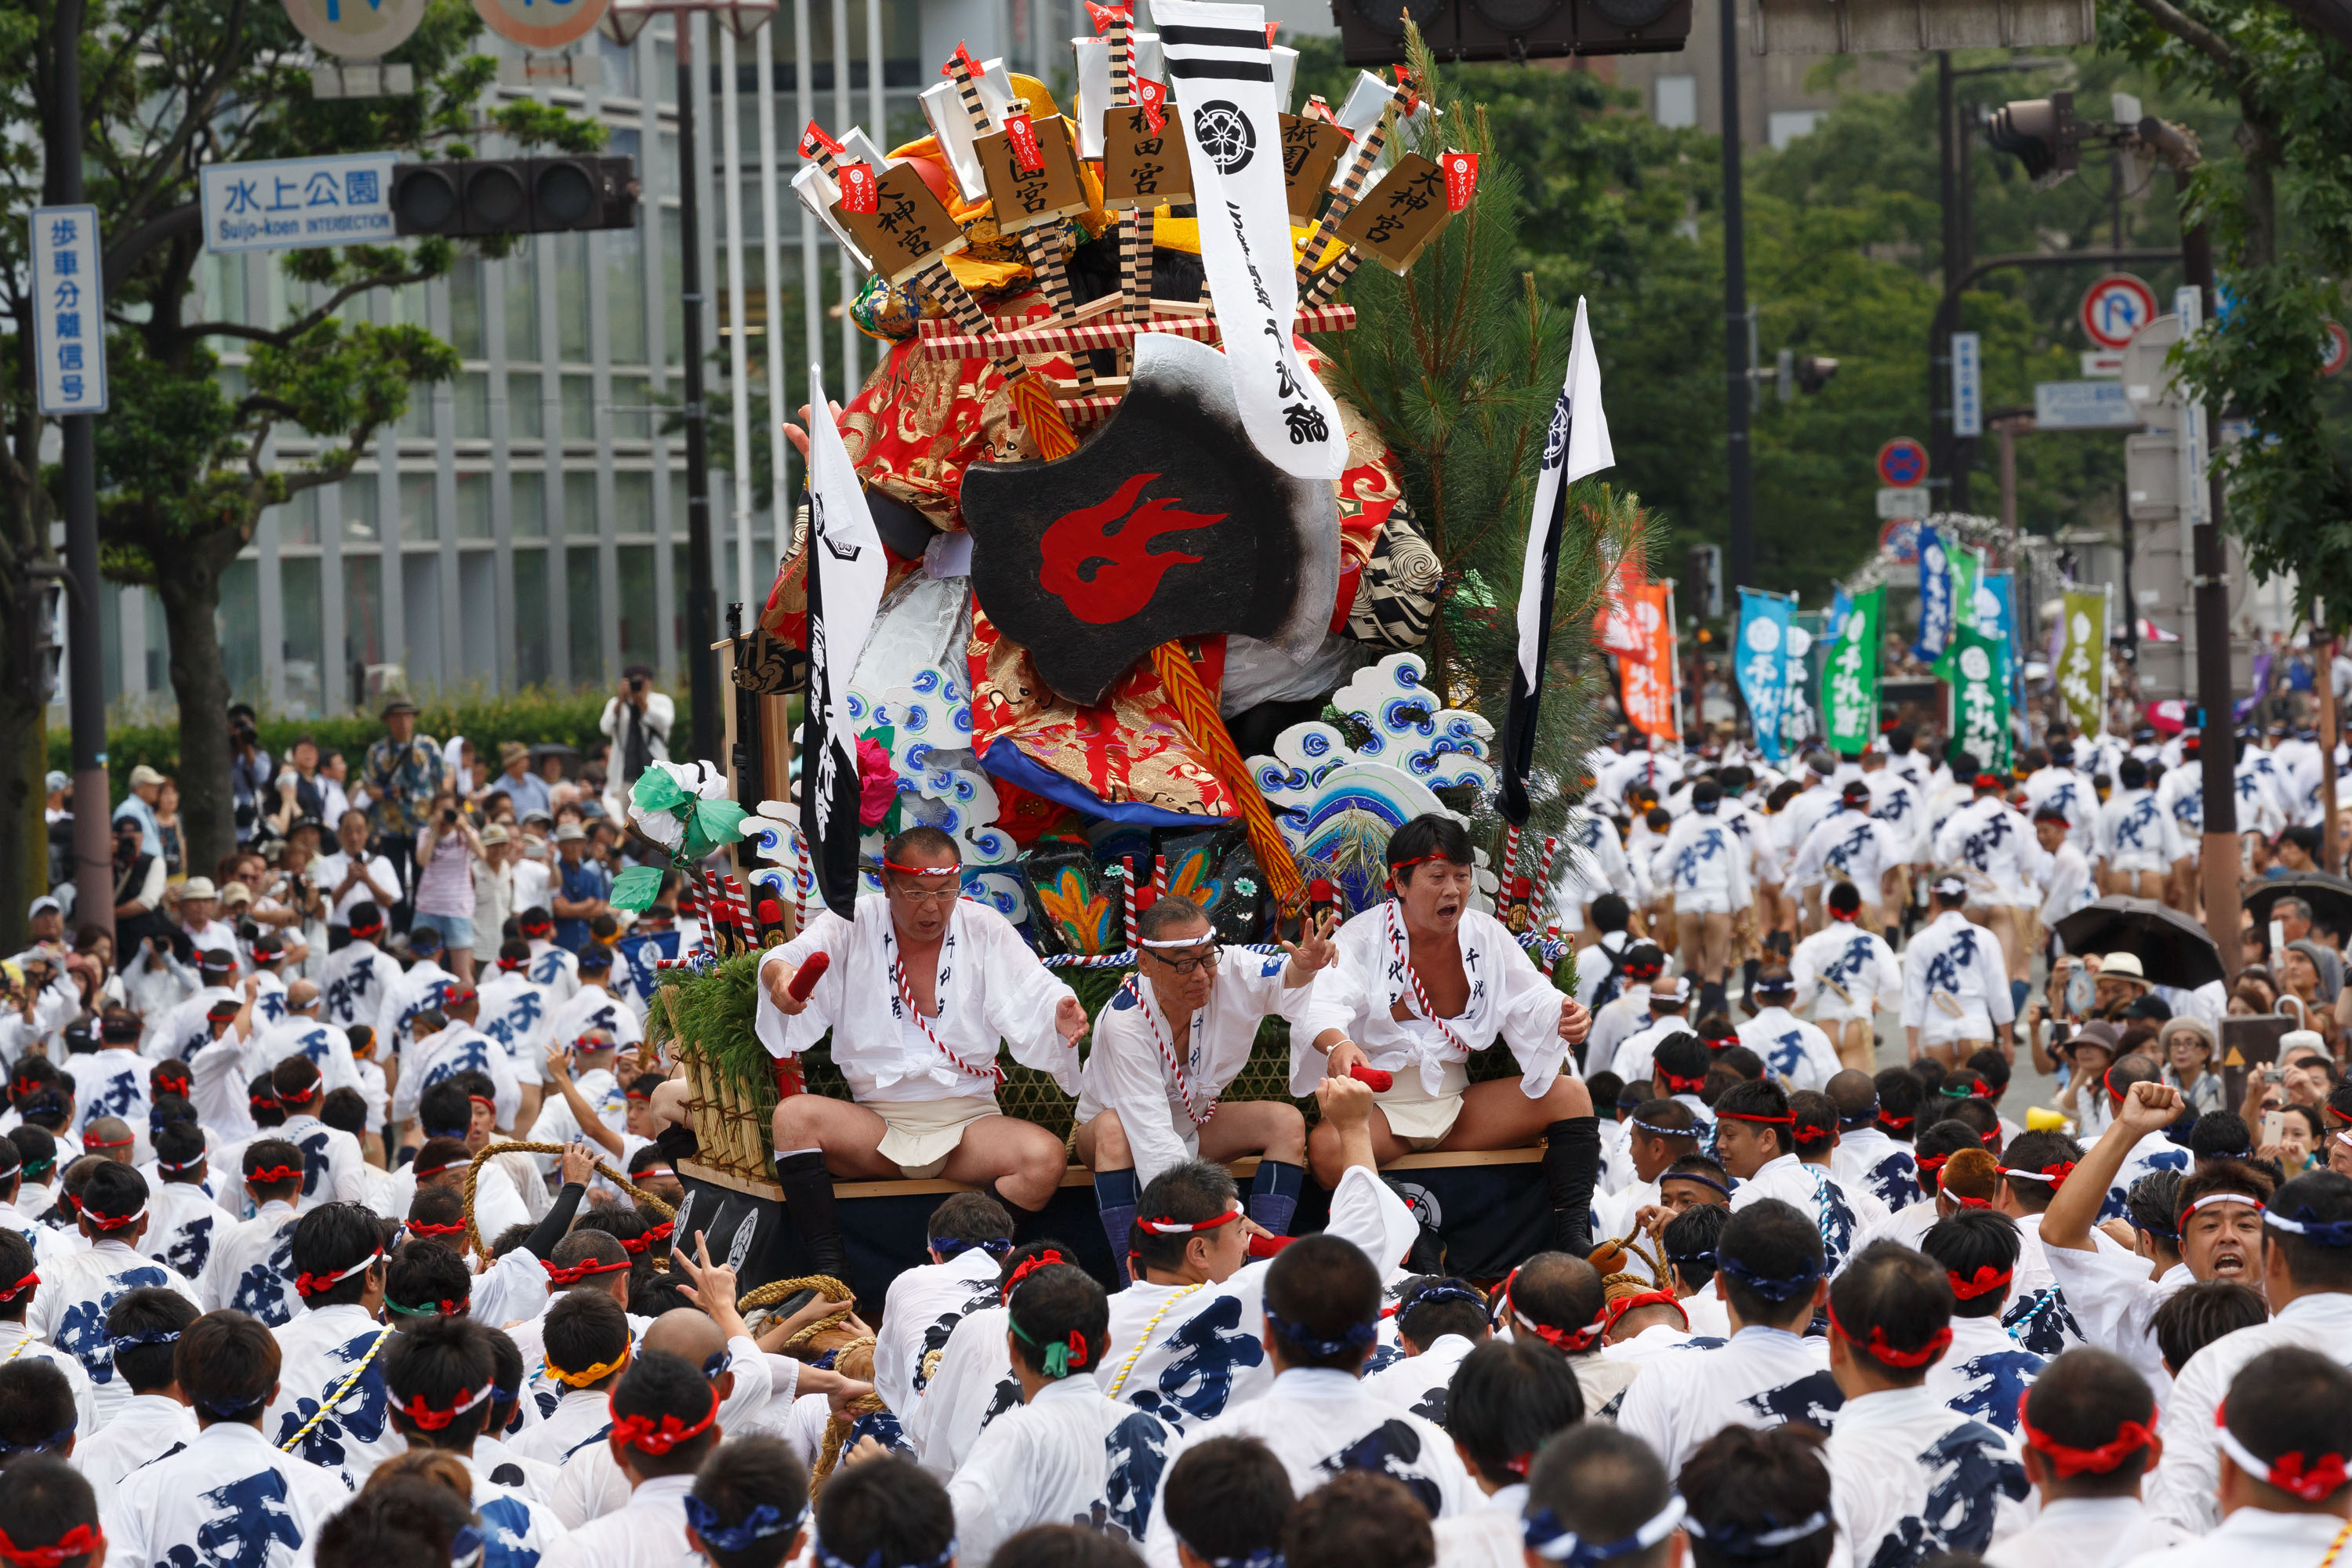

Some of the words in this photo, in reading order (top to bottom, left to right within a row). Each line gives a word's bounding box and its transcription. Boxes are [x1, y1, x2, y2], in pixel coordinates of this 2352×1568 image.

[1283, 119, 1318, 187] 祇園
[224, 169, 380, 213] 水上公園
[1367, 169, 1443, 243] 大神宮
[220, 216, 300, 241] Suijo-koen
[51, 218, 85, 401] 歩車分離信号
